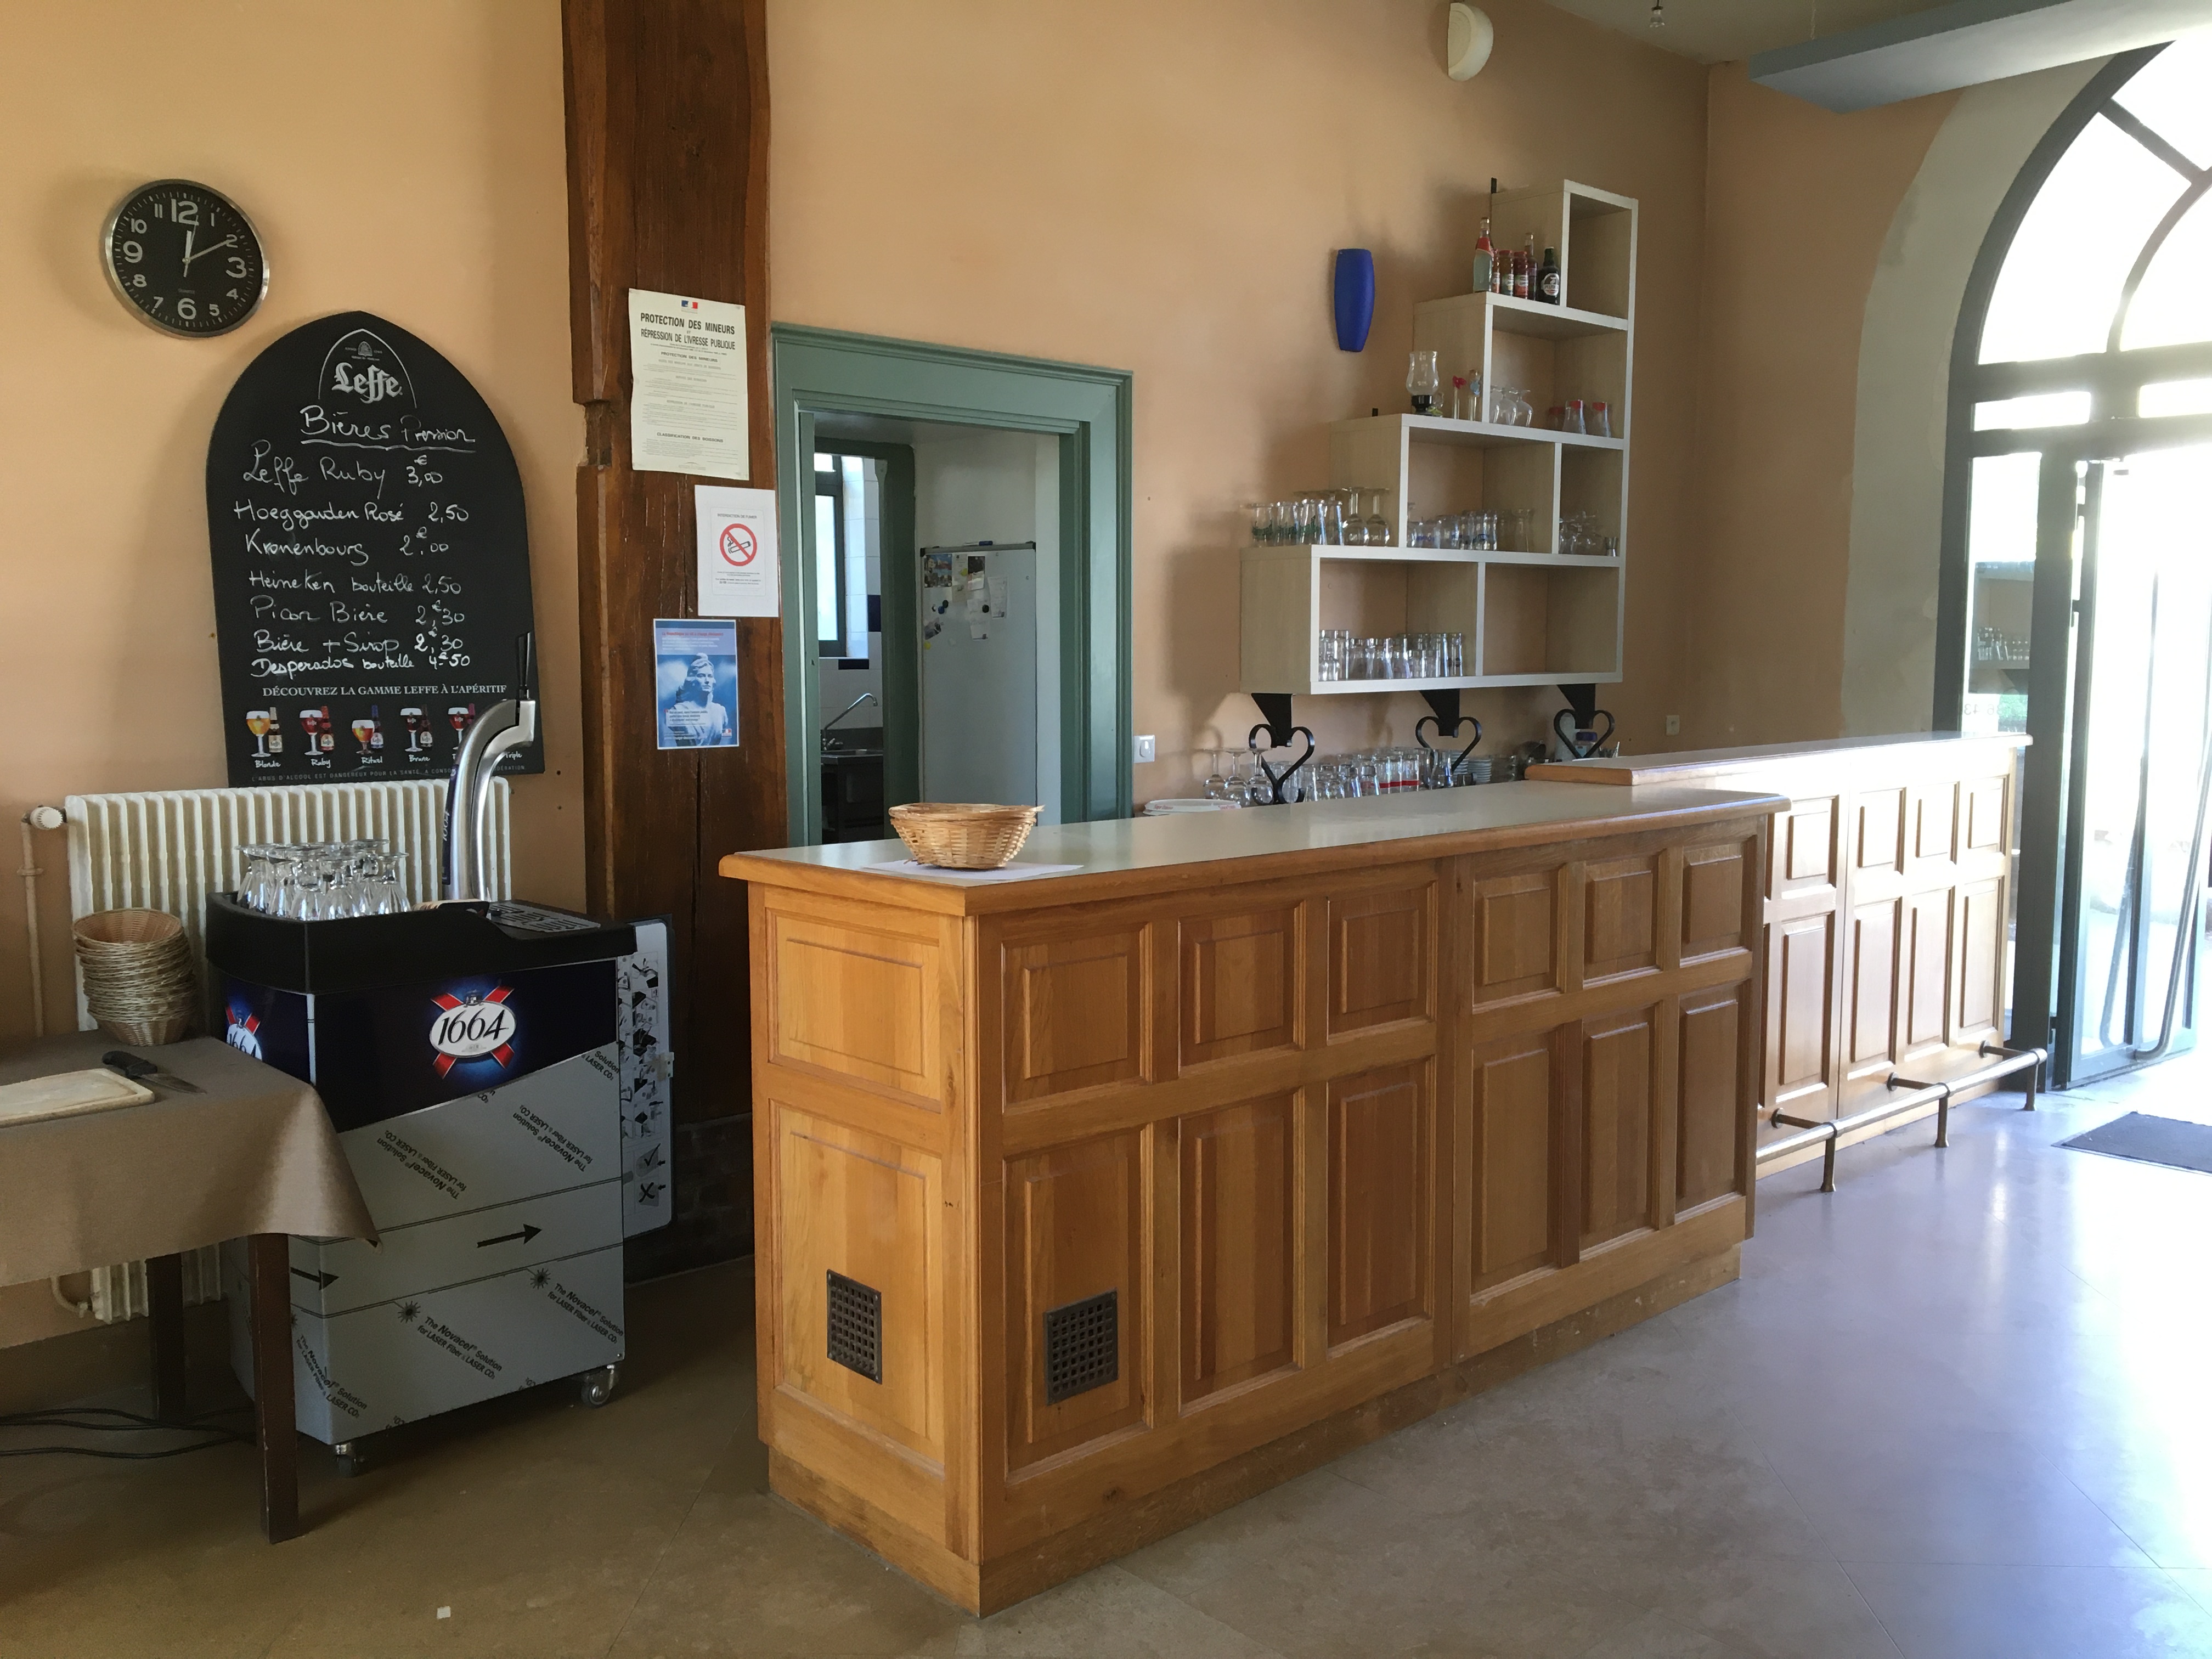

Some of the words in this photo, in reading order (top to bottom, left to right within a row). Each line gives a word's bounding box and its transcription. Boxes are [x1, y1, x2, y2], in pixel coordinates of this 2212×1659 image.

[154, 204, 163, 218] 11
[171, 199, 199, 226] 12
[211, 213, 215, 227] 1
[131, 218, 147, 234] 10
[123, 241, 143, 263] 9
[226, 234, 239, 249] 2
[225, 257, 247, 279] 3
[133, 274, 147, 287] 8
[153, 296, 163, 309] 7
[226, 289, 239, 299] 4
[177, 298, 196, 320] 6
[209, 303, 219, 317] 5
[640, 313, 685, 328] PROTECTION
[689, 320, 701, 330] DES
[706, 322, 735, 335] MINEURS
[641, 327, 673, 341] RÉPRESSION
[675, 334, 682, 343] DE
[684, 335, 708, 346] L'IVRESSE
[710, 338, 736, 349] PUBLIQUE
[331, 362, 403, 404] Leffe
[320, 456, 385, 500] Ruby
[364, 501, 405, 522] Rosé
[245, 528, 369, 566] Kronenbourg
[351, 572, 414, 593] bouteille
[250, 656, 354, 680] Desperados
[263, 686, 338, 696] DÉCOUVREZ
[340, 687, 356, 695] LA
[358, 686, 402, 695] GAMME
[404, 686, 439, 695] LEFFE
[441, 684, 449, 694] À
[451, 683, 507, 694] L'APÉRITIF
[438, 1007, 509, 1046] 1664
[585, 1055, 604, 1073] LASER
[595, 1051, 619, 1074] Solution
[512, 1112, 539, 1136] Solution
[530, 1113, 549, 1131] LASER
[396, 1138, 417, 1157] LASER
[552, 1131, 567, 1144] Fiber
[377, 1138, 407, 1162] Solution
[566, 1141, 584, 1158] LASER
[583, 1154, 593, 1164] for
[421, 1156, 438, 1171] Fiber
[574, 1160, 586, 1172] The
[437, 1167, 458, 1185] LASER
[456, 1181, 467, 1192] for
[446, 1186, 459, 1200] The
[548, 1291, 557, 1300] for
[556, 1297, 574, 1313] LASER
[573, 1310, 588, 1322] Fiber
[590, 1322, 608, 1337] LASER
[555, 1283, 566, 1295] The
[600, 1316, 624, 1336] Solution
[417, 1325, 428, 1335] for
[426, 1331, 447, 1348] LASER
[445, 1344, 462, 1358] Fiber
[465, 1356, 485, 1372] LASER
[425, 1316, 438, 1329] The
[475, 1350, 503, 1372] Solution
[302, 1350, 314, 1373] LASER
[326, 1393, 348, 1411] LASER
[337, 1387, 368, 1410] Solution
